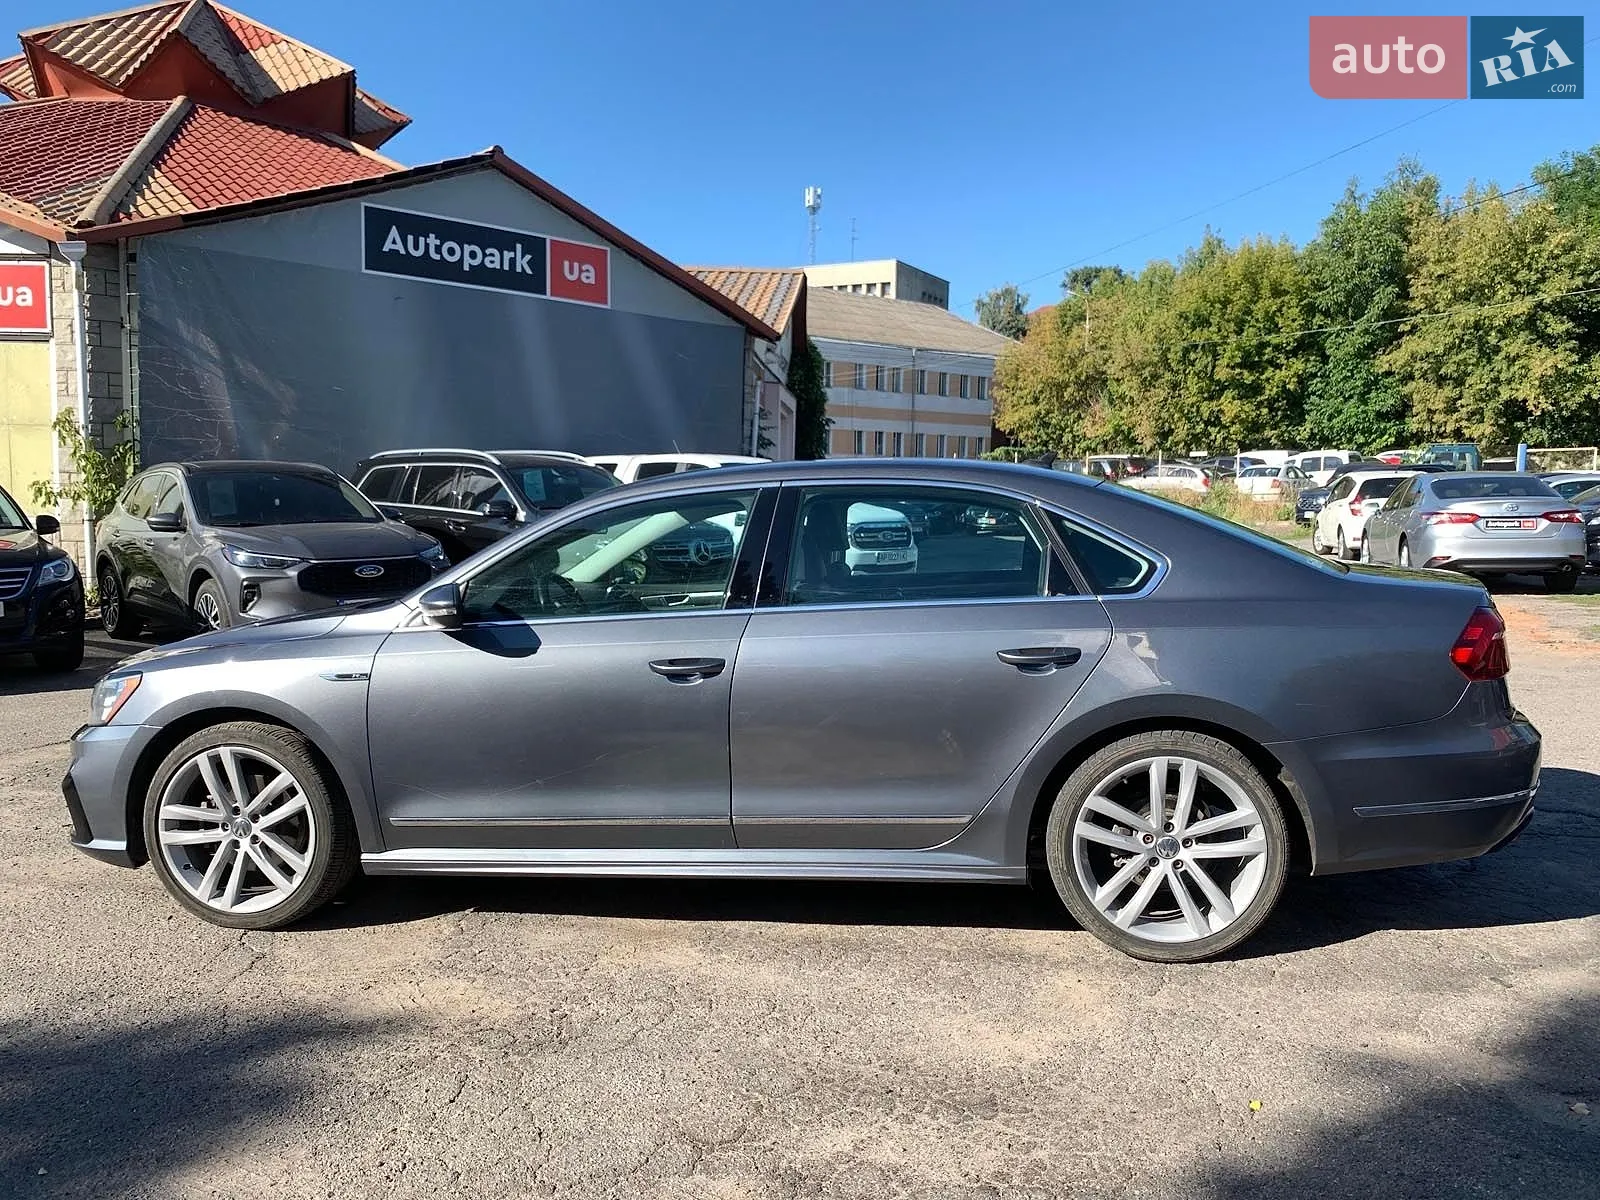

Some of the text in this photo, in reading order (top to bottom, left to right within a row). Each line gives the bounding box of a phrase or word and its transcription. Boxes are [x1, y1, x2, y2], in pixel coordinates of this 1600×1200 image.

[382, 224, 596, 285] Autopark ua
[0, 285, 33, 307] ua
